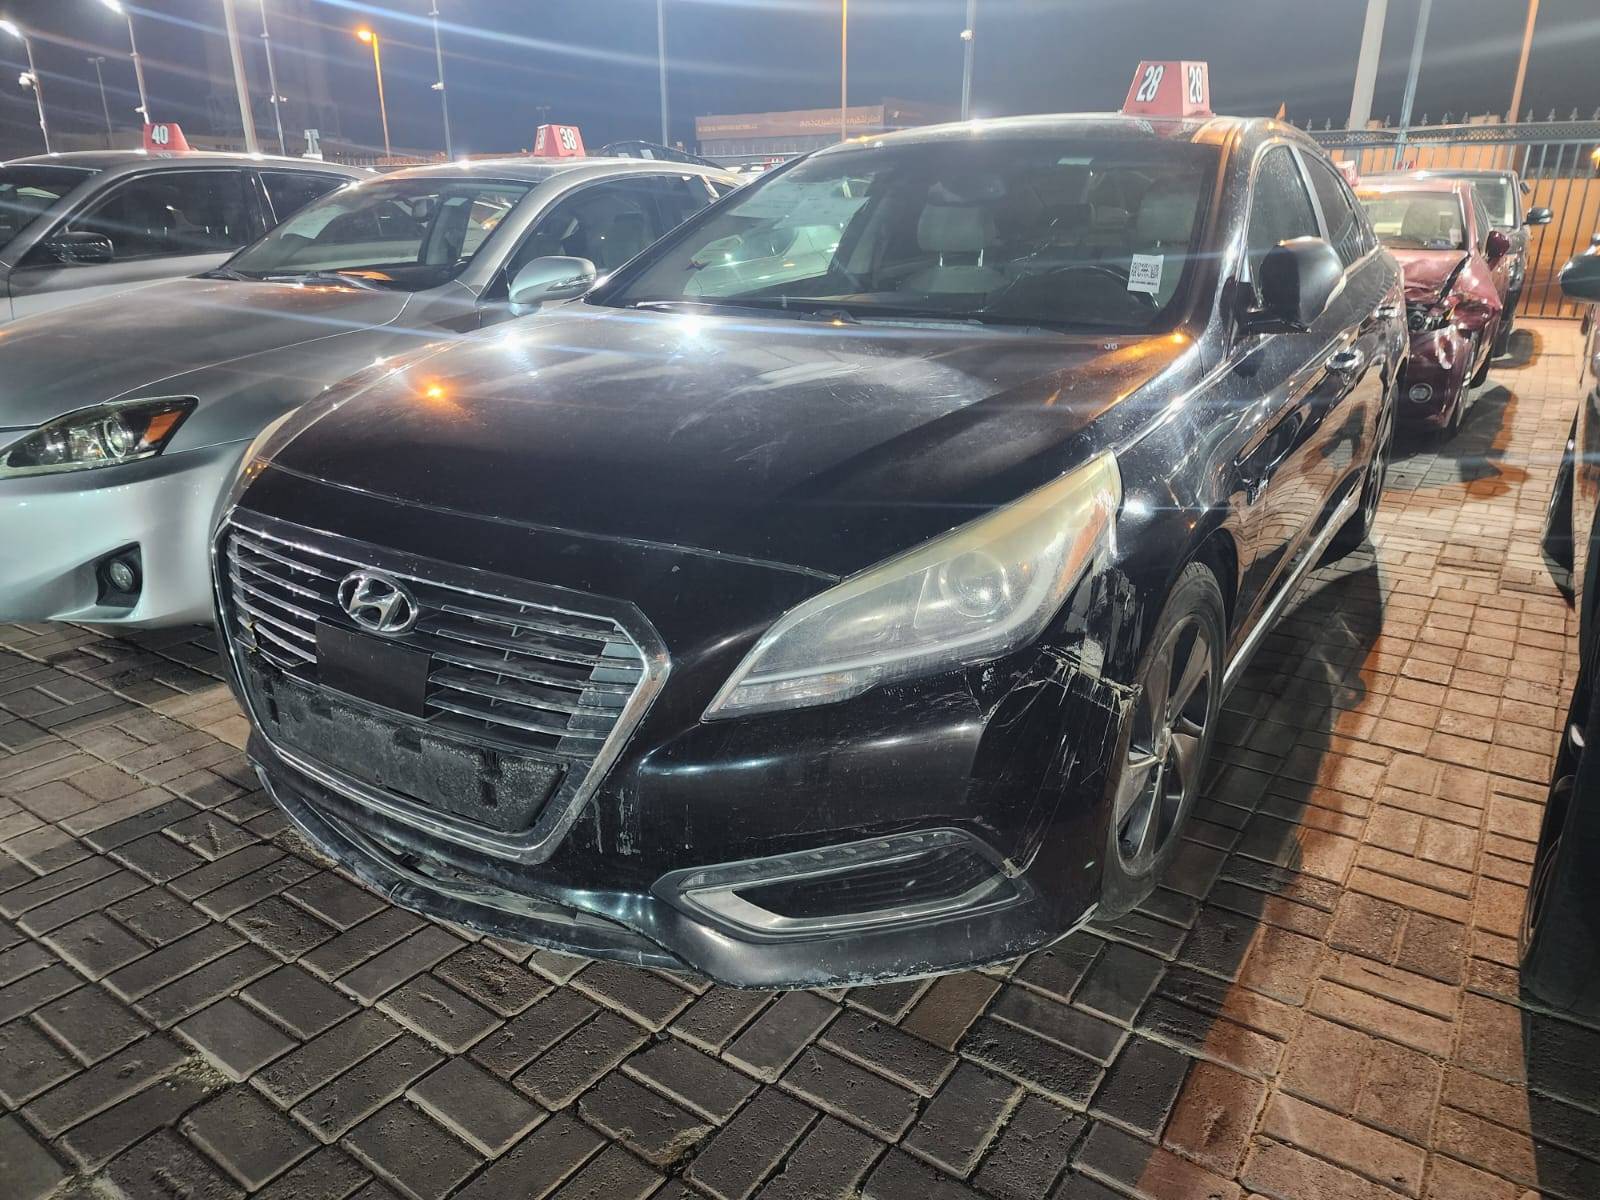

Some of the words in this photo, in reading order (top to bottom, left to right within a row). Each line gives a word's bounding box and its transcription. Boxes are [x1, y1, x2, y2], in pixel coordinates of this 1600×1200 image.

[1135, 65, 1164, 102] 28
[1188, 66, 1203, 103] 28
[151, 124, 169, 145] 40
[560, 127, 577, 150] 38
